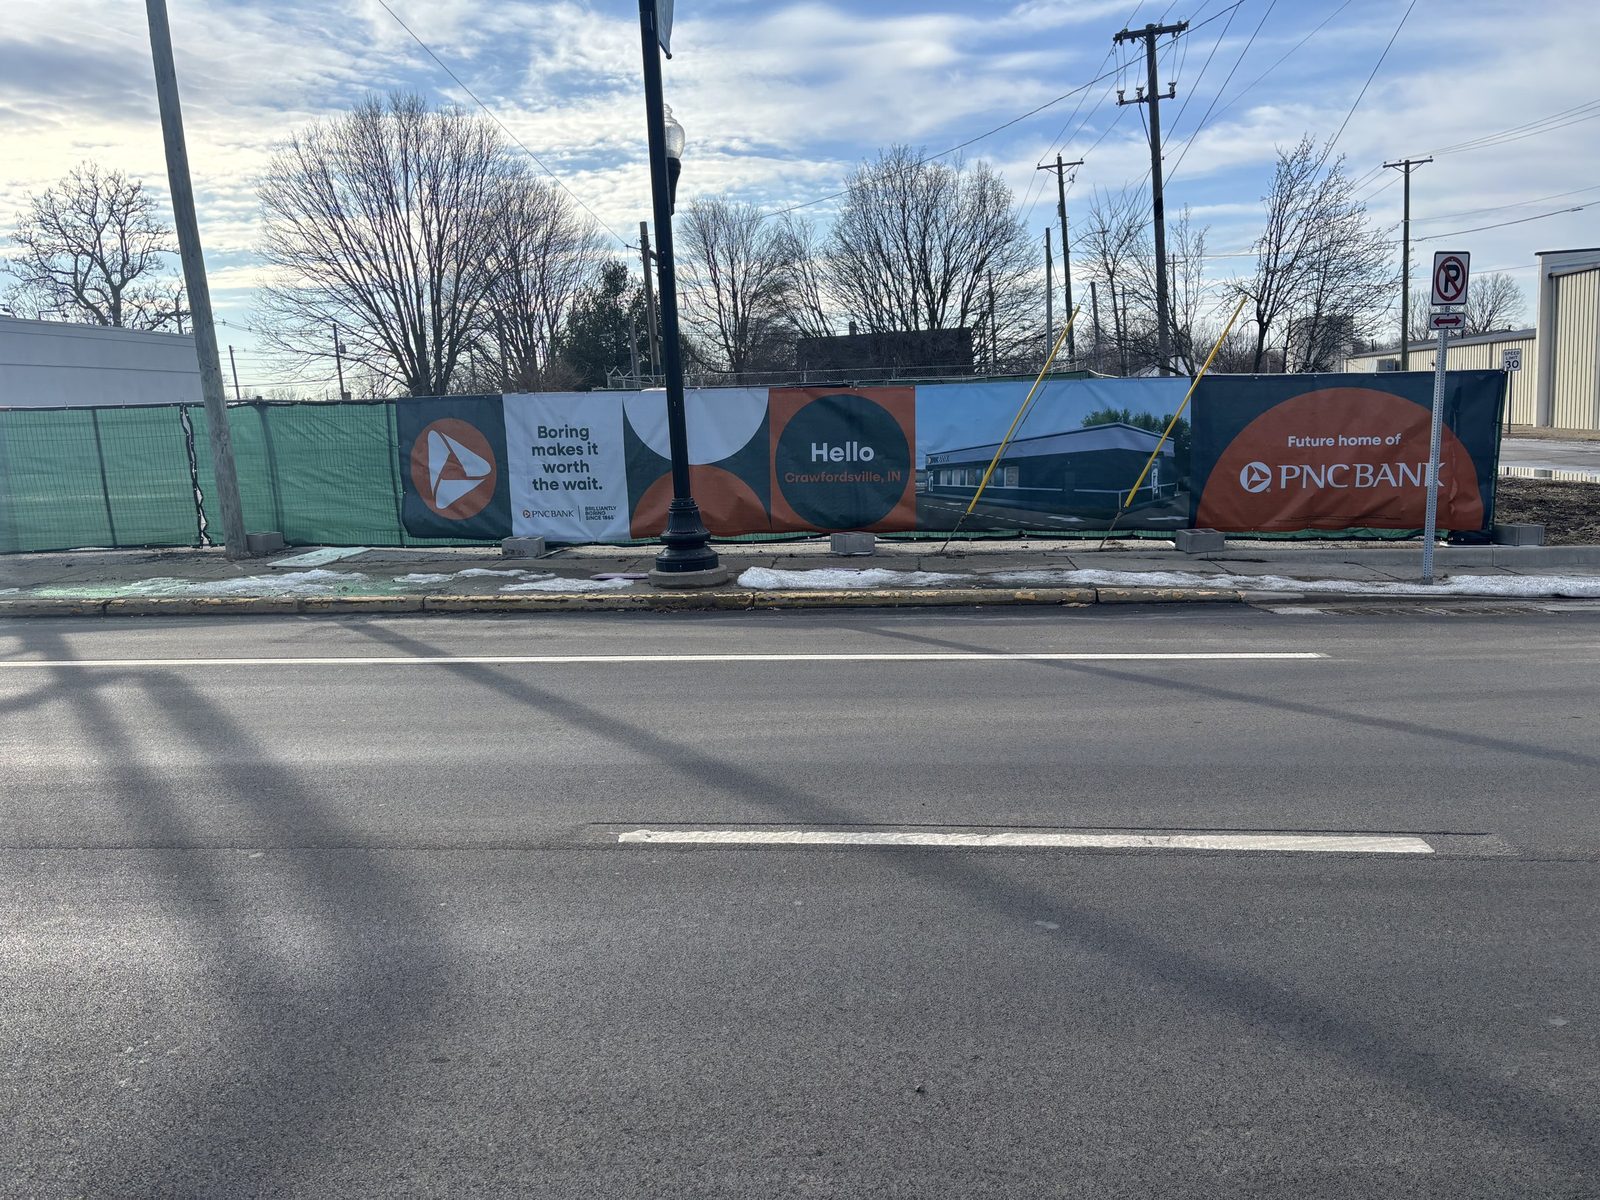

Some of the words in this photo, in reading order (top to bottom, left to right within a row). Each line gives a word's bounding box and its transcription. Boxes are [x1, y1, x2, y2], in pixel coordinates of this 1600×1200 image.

[1505, 360, 1519, 369] 30
[537, 424, 589, 440] Boring
[1287, 436, 1335, 448] Future
[1338, 434, 1381, 447] home
[1385, 433, 1401, 446] of
[531, 443, 584, 456] makes
[587, 442, 599, 455] it
[811, 441, 875, 462] Hello
[542, 460, 590, 473] worth
[784, 471, 885, 484] Crawfordsville,
[887, 471, 901, 482] IN
[1277, 463, 1351, 489] PNC
[532, 478, 559, 491] the
[562, 477, 603, 491] wait.
[532, 510, 550, 518] PNC
[551, 510, 575, 518] BANK
